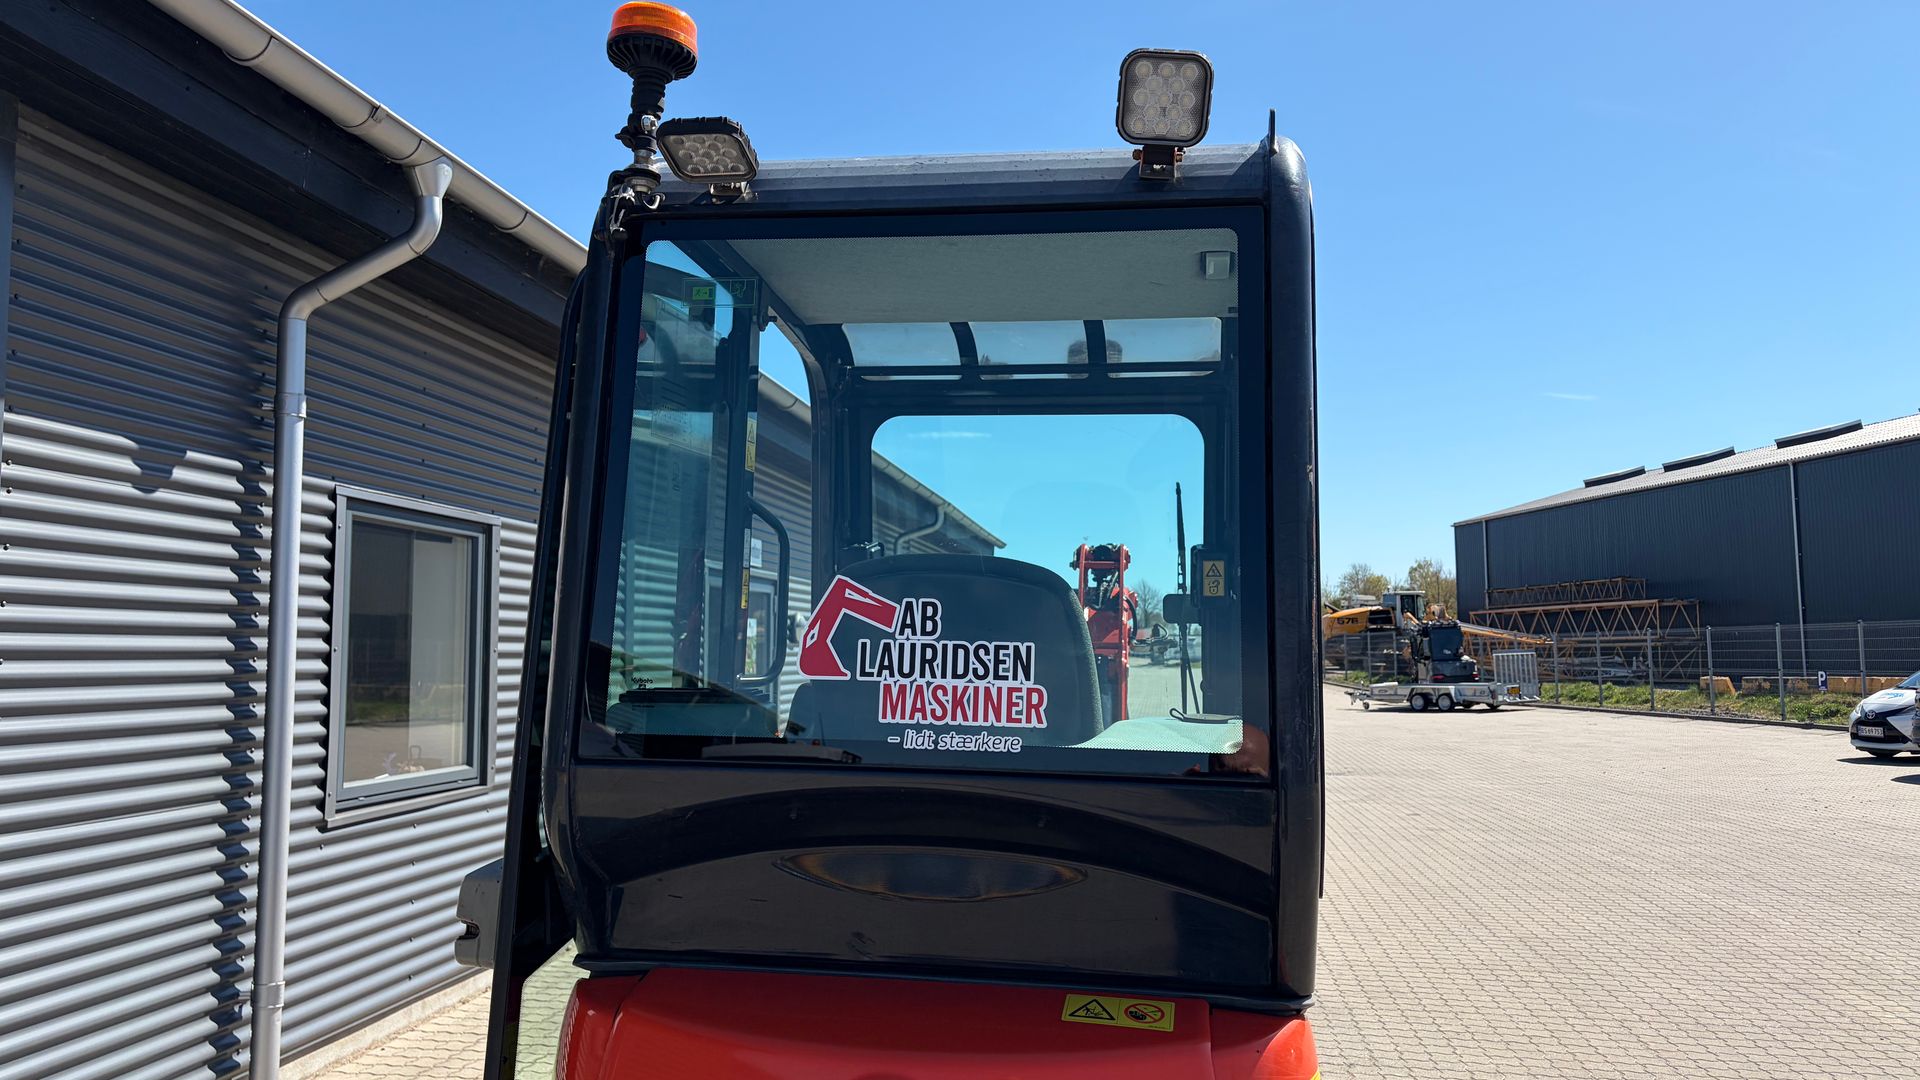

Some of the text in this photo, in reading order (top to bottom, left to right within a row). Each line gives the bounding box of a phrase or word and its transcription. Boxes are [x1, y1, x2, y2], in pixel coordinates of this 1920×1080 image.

[898, 600, 940, 638] AB
[858, 641, 1033, 682] LAURIDSEN
[1818, 671, 1826, 686] P
[880, 683, 1045, 725] MASKINER
[903, 730, 935, 750] lidt
[939, 732, 1021, 752] stærkere
